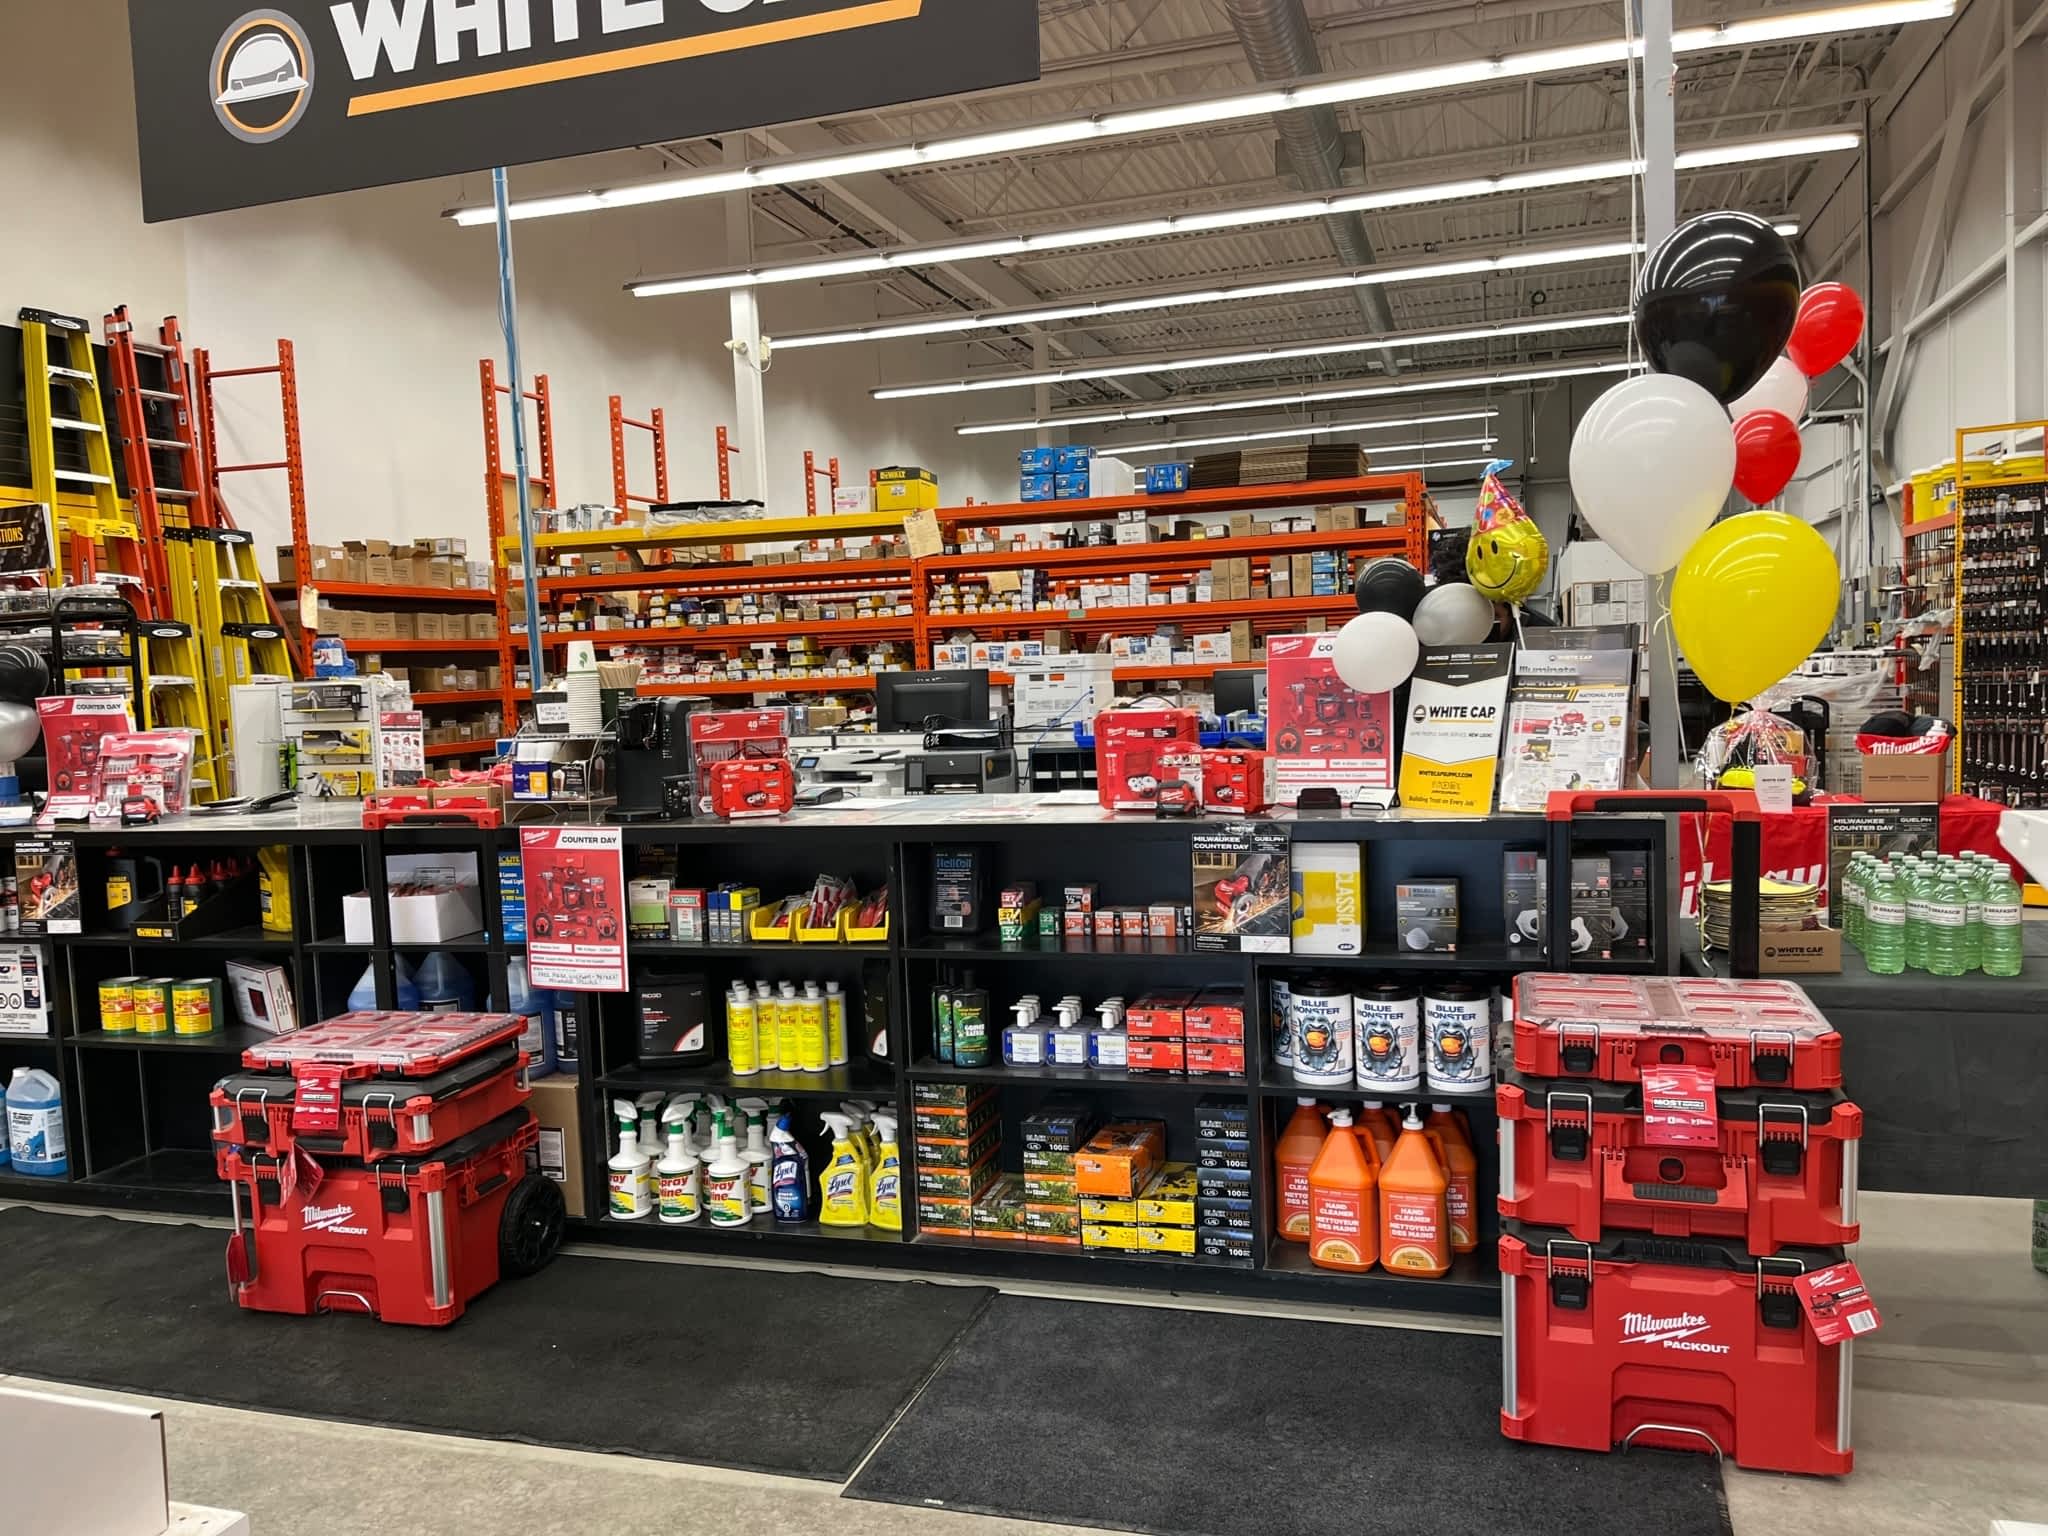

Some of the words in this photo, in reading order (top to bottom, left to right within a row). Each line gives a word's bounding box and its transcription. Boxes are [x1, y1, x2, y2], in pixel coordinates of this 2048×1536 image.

[1429, 706, 1468, 718] WHITE
[1470, 706, 1496, 719] CAP
[1868, 734, 1941, 755] Milwaukee
[561, 836, 598, 844] COUNTER
[1301, 1000, 1329, 1008] BLUE
[1364, 1003, 1392, 1012] BLUE
[1435, 1004, 1465, 1013] BLUE
[1293, 1004, 1340, 1015] MONSTER
[776, 1163, 795, 1179] Lysol
[828, 1177, 853, 1193] Lysol
[877, 1179, 897, 1193] Lysol
[301, 1204, 353, 1223] Milwaukee
[1320, 1208, 1354, 1217] CLEANER
[1315, 1217, 1359, 1226] NETTOYEUR
[1394, 1215, 1430, 1223] CLEANER
[328, 1225, 368, 1234] PACKOUT
[1389, 1223, 1436, 1232] NETTOYEUR
[1408, 1231, 1434, 1239] MAINS
[1618, 1312, 1707, 1335] Milwaukee
[1663, 1340, 1730, 1353] PACKOUT
